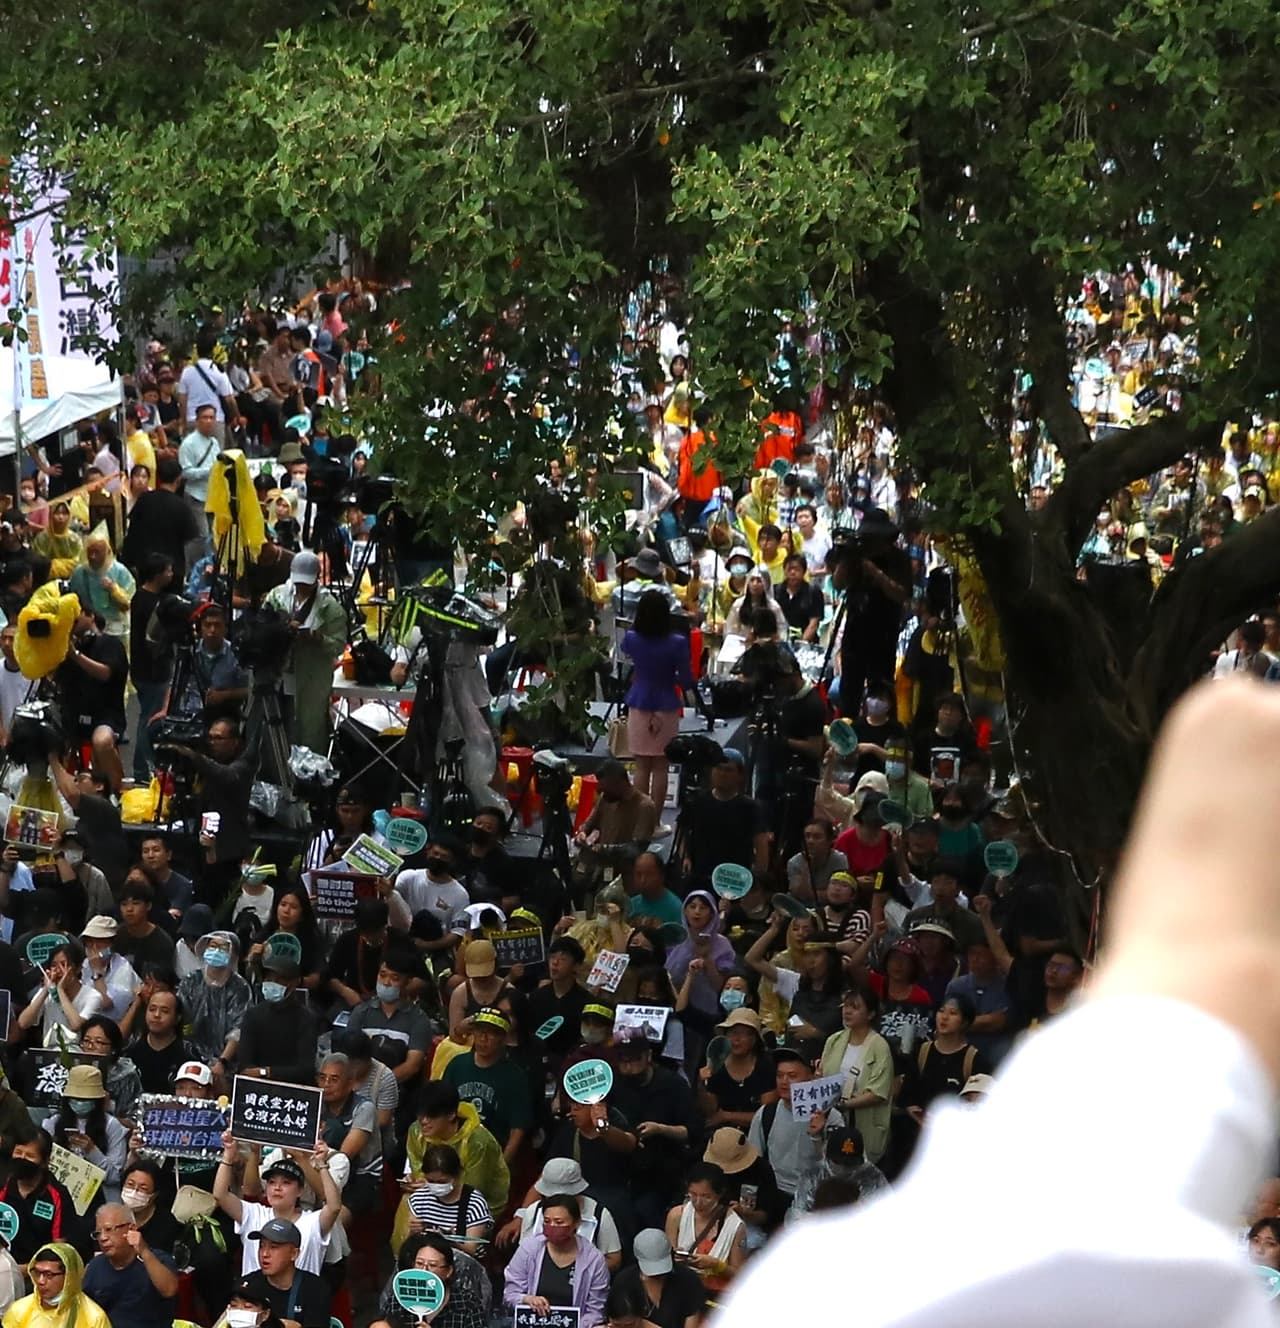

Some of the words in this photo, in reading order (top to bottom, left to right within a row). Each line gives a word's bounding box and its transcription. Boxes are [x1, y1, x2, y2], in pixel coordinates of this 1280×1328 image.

[245, 1092, 309, 1115] 國民黨不倒
[145, 1108, 226, 1127] 我是追星人
[244, 1107, 308, 1129] 台灣不會好
